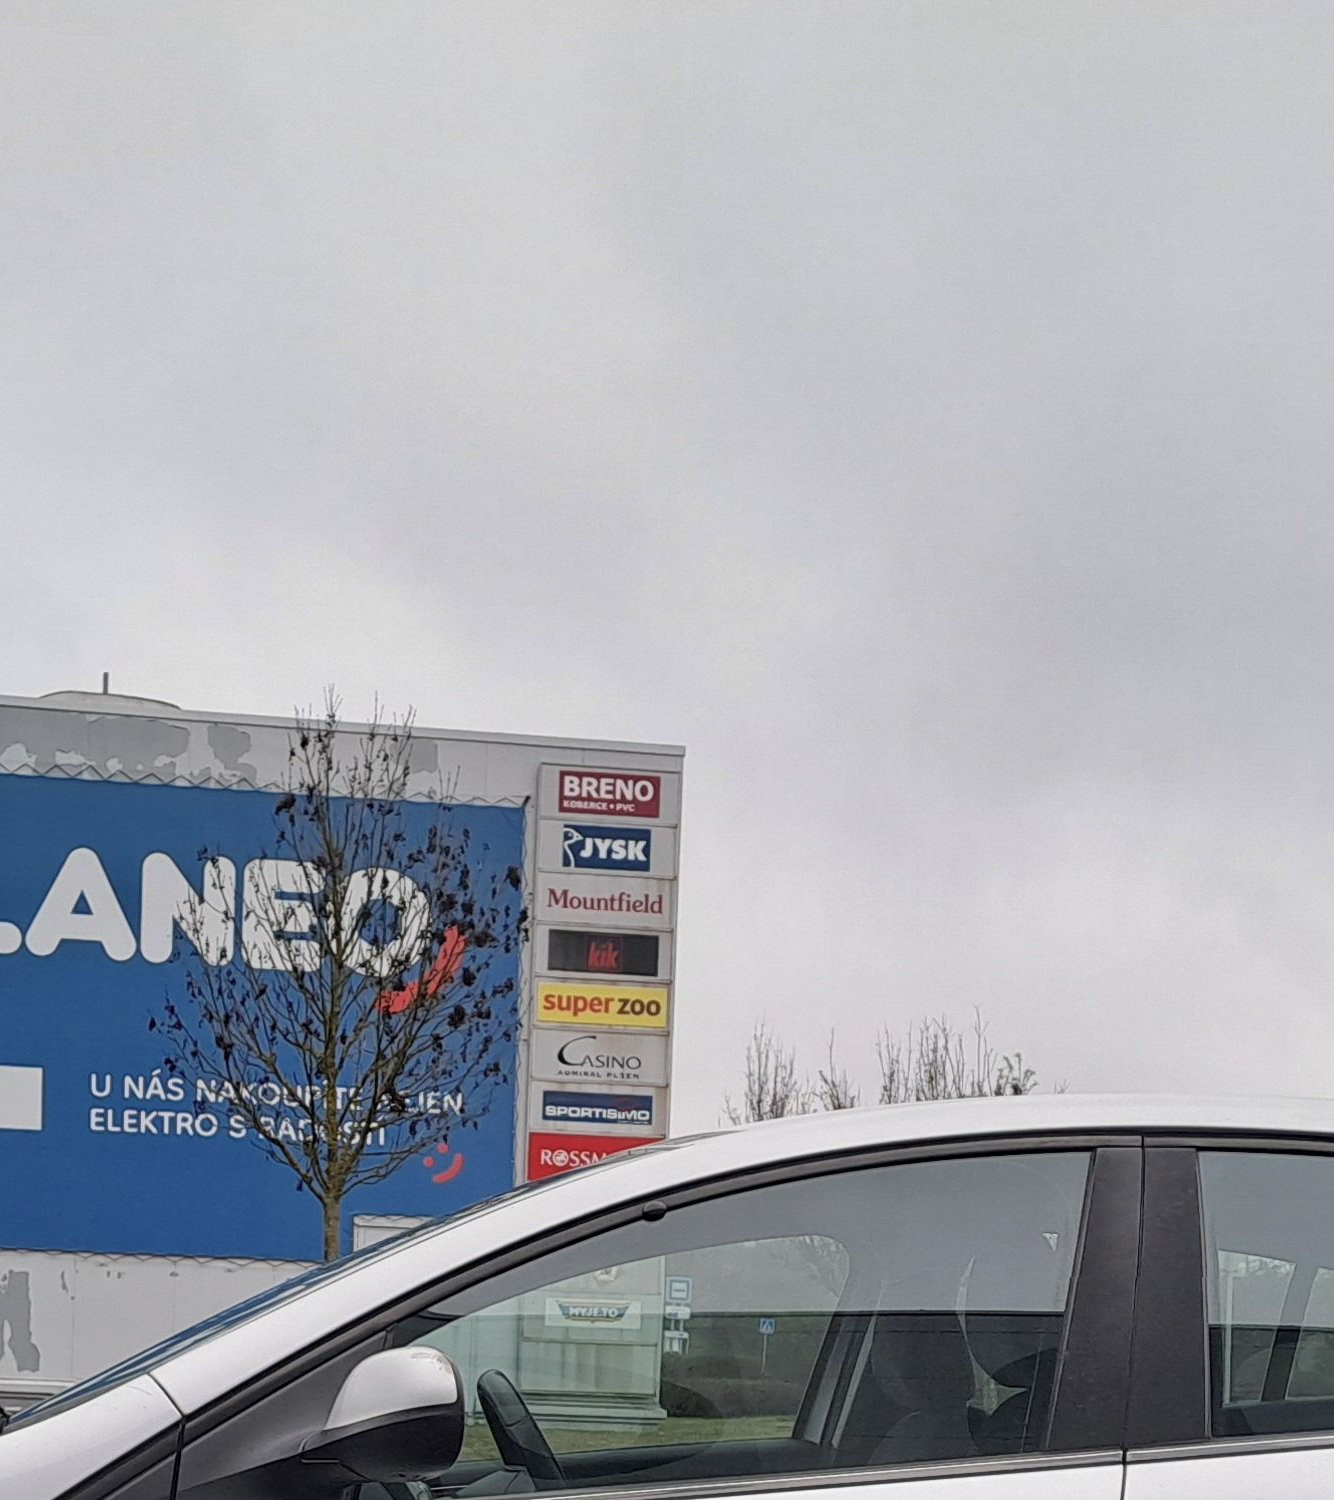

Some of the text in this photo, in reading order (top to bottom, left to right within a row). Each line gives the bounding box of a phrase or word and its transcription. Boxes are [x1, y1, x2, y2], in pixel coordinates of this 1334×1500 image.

[563, 775, 654, 802] BRENO
[616, 802, 635, 812] PVC
[580, 837, 647, 861] JYSK
[547, 888, 663, 914] Mountfield
[90, 1073, 111, 1097] U
[124, 1068, 184, 1101] NÁS
[377, 1090, 463, 1116] JEN
[90, 1108, 218, 1137] ELEKTRO
[229, 1115, 246, 1138] S
